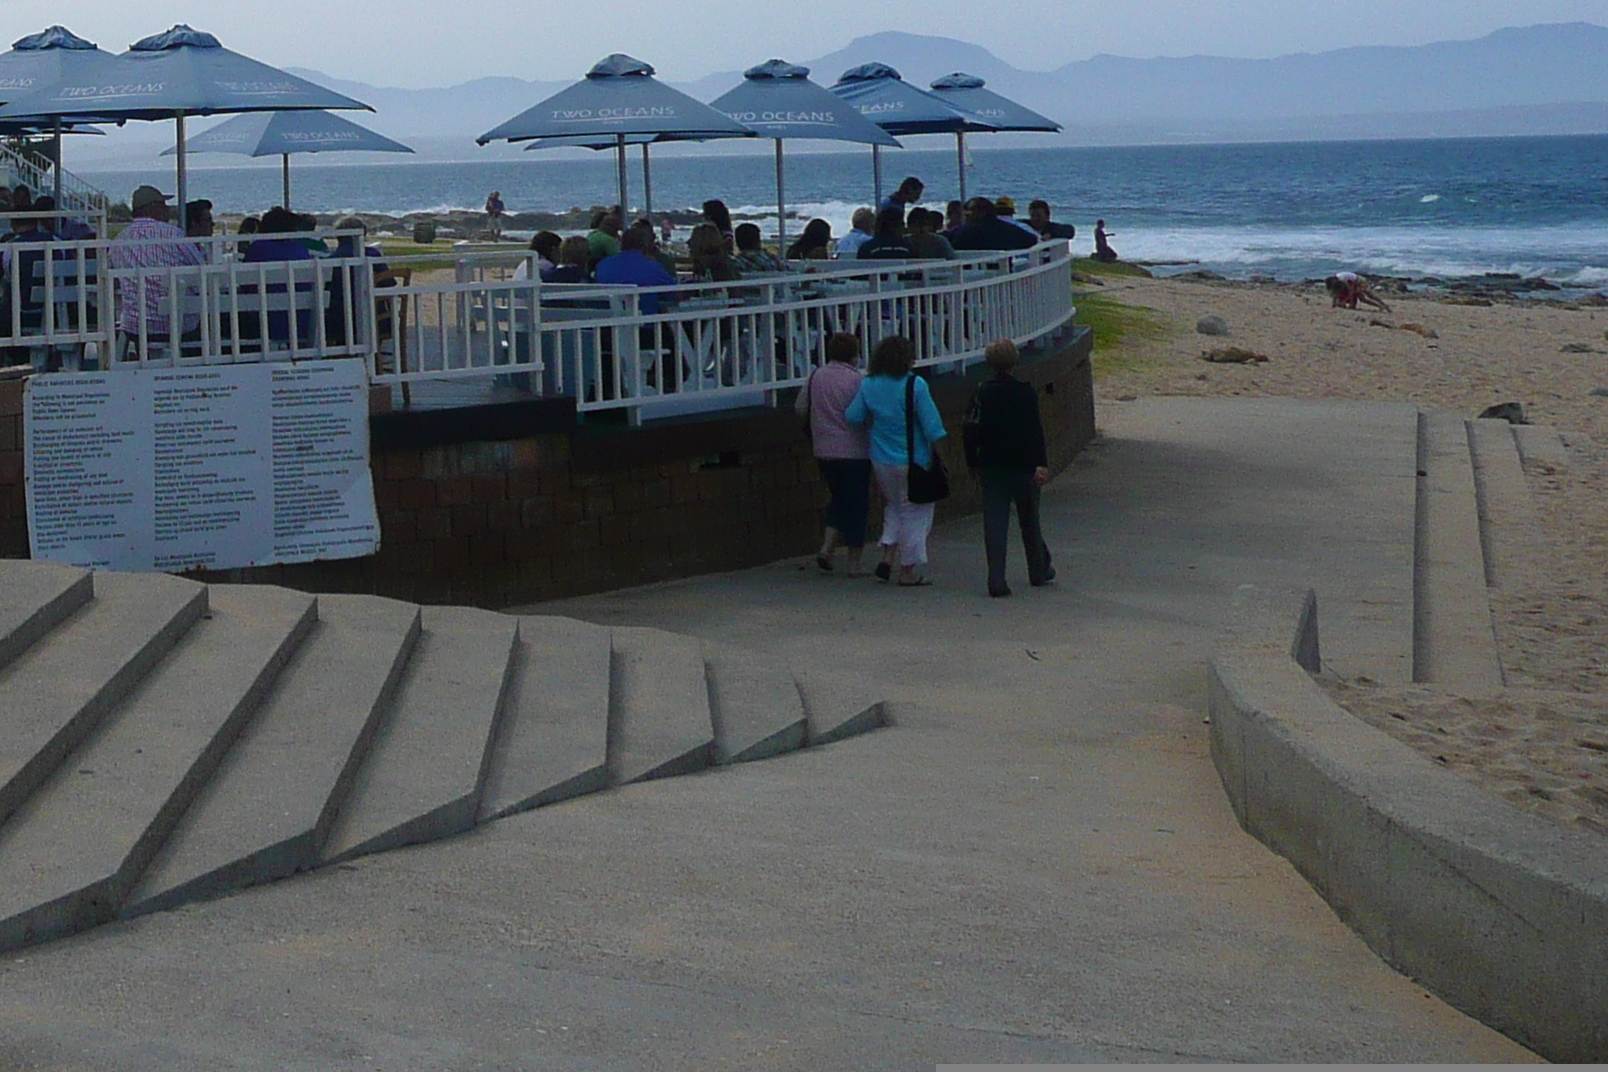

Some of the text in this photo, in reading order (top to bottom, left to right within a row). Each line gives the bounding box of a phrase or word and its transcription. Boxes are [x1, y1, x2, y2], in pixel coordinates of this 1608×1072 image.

[60, 82, 167, 97] TWO OCEANS
[552, 106, 675, 119] TWO OCEANS
[853, 100, 904, 114] EANS
[975, 108, 1005, 116] ANS
[730, 111, 834, 122] WO OCEANS
